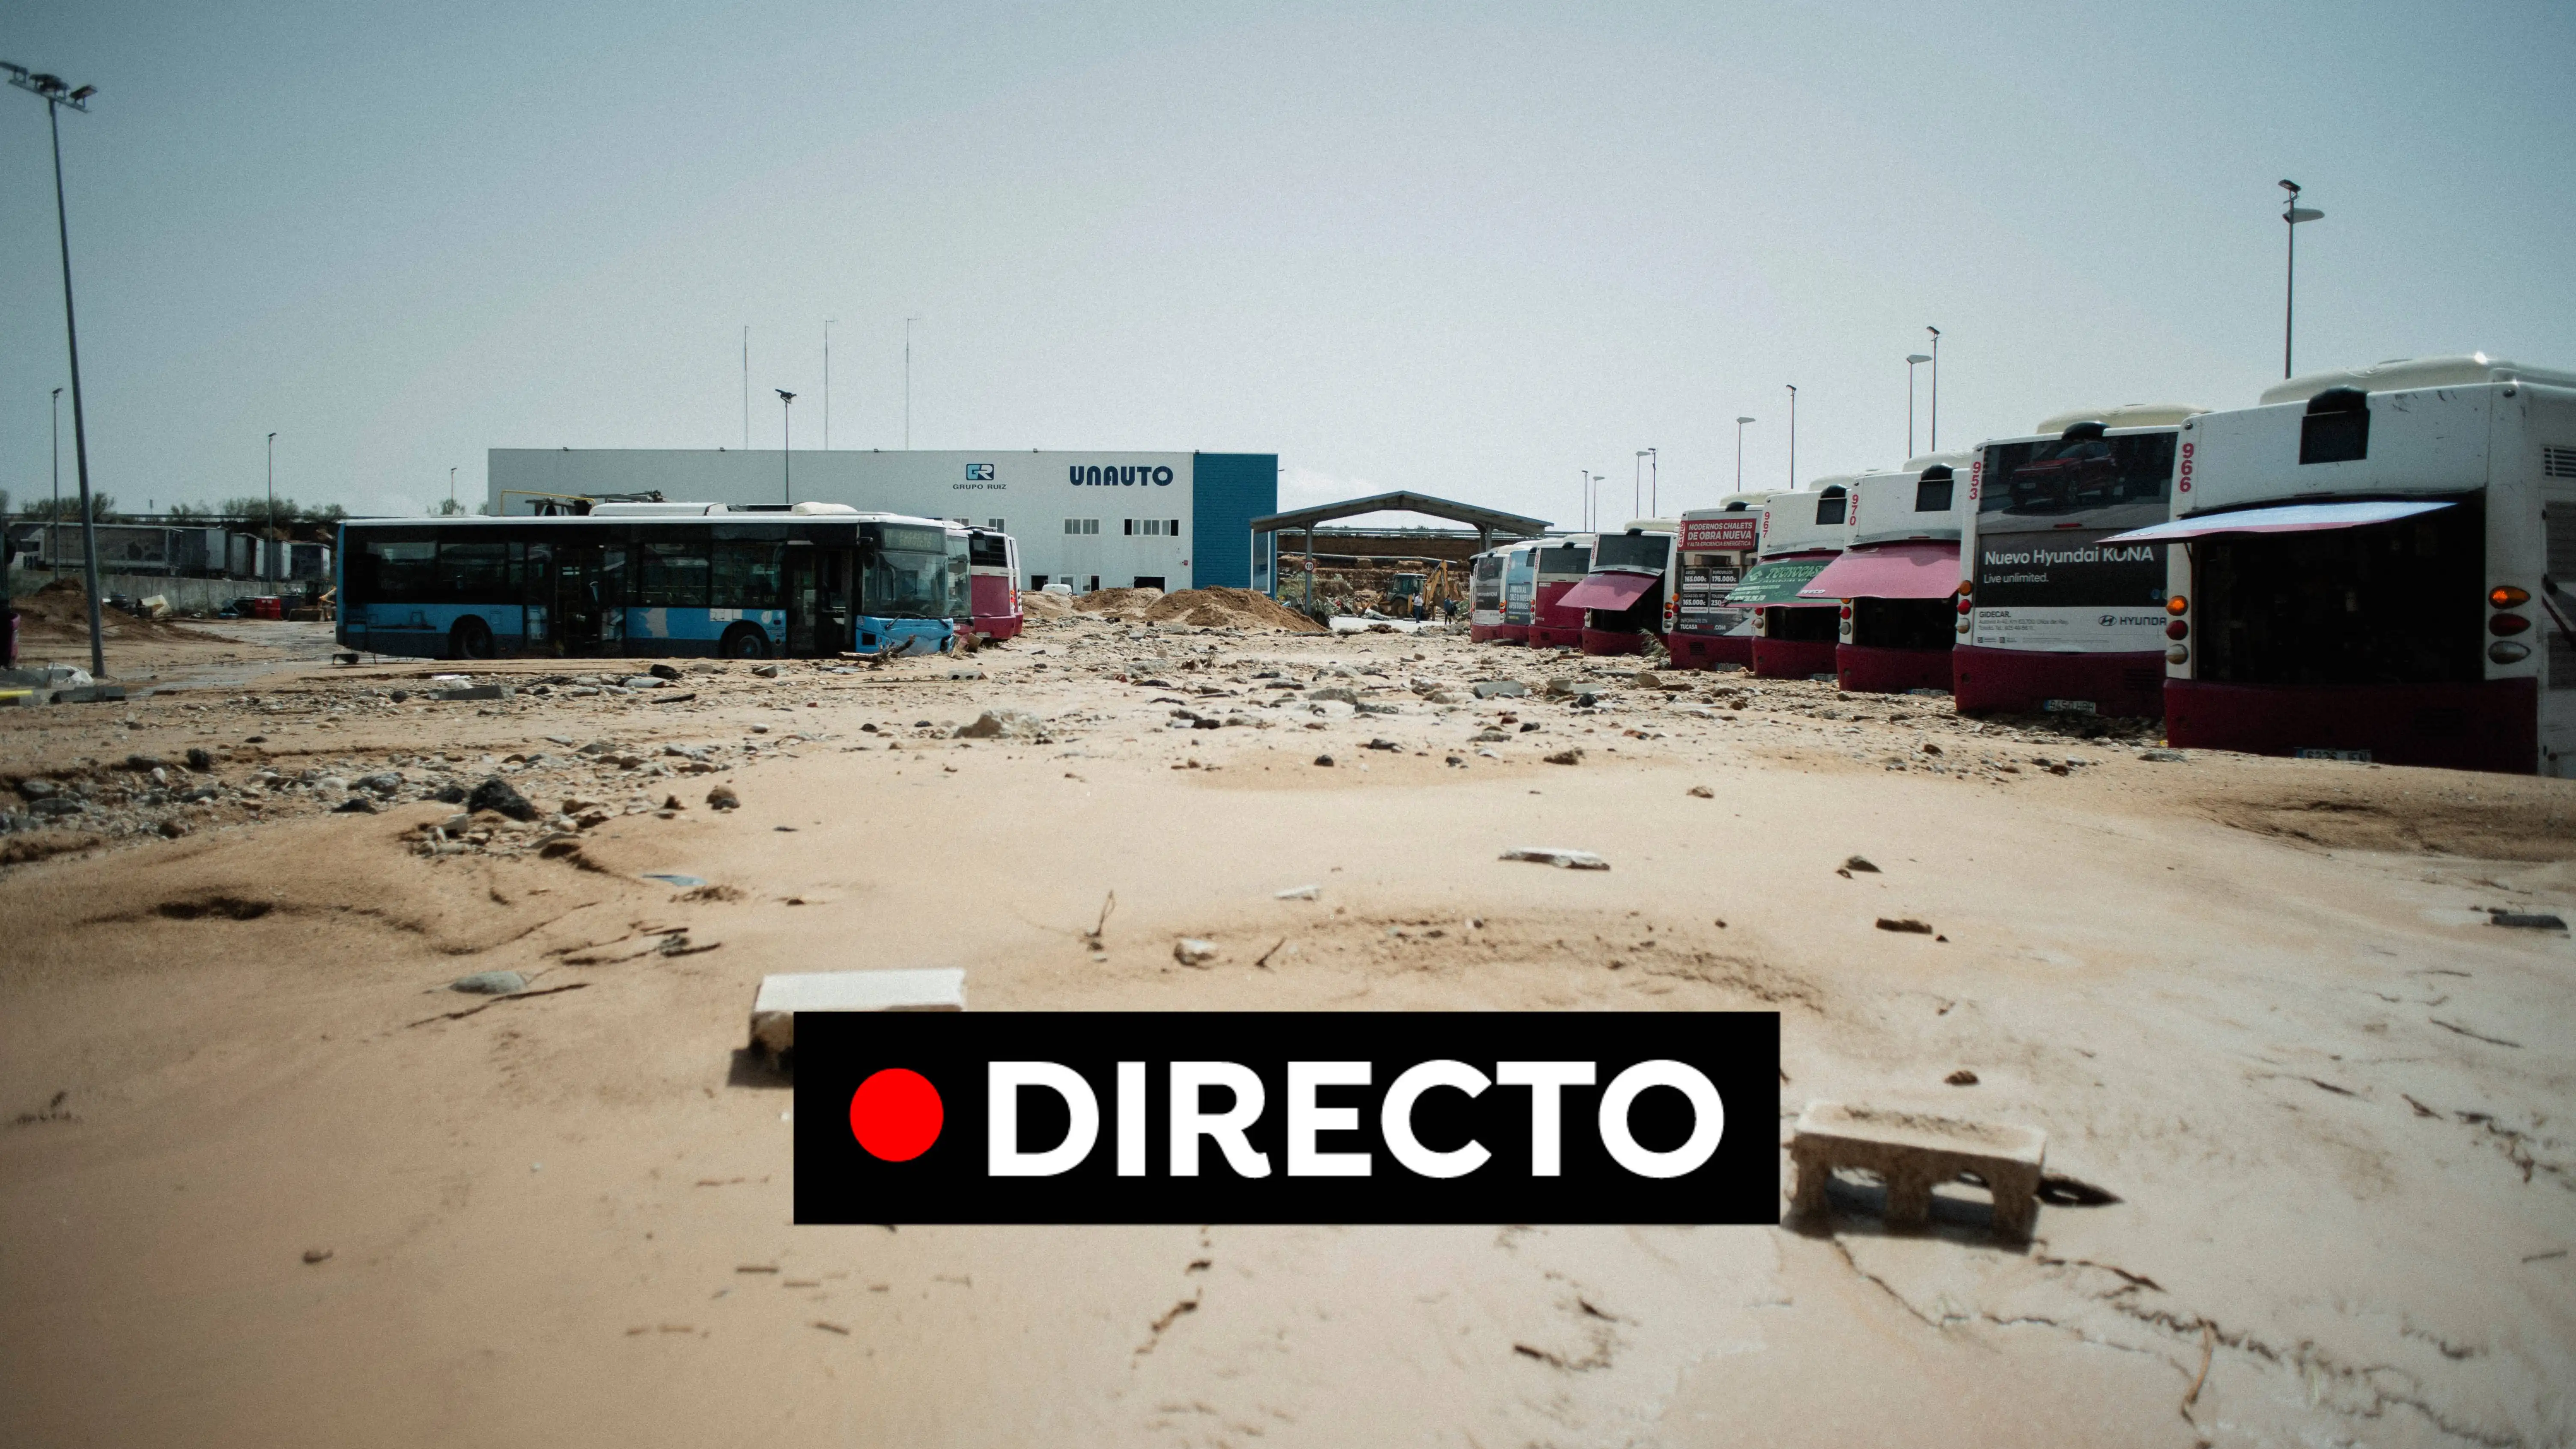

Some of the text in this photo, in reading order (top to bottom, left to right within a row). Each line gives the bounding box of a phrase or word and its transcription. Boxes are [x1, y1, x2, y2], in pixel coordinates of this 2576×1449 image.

[1070, 465, 1174, 486] UNAUTO
[2180, 443, 2194, 492] 966
[1970, 461, 1982, 500] 953
[1849, 494, 1859, 526] 970
[1688, 531, 1752, 540] DE OBRA NUEVA
[1985, 546, 2154, 566] Nuevo Hyundai KONA
[1984, 573, 2049, 583] Live unlimited.
[2120, 617, 2167, 626] HYUNDA
